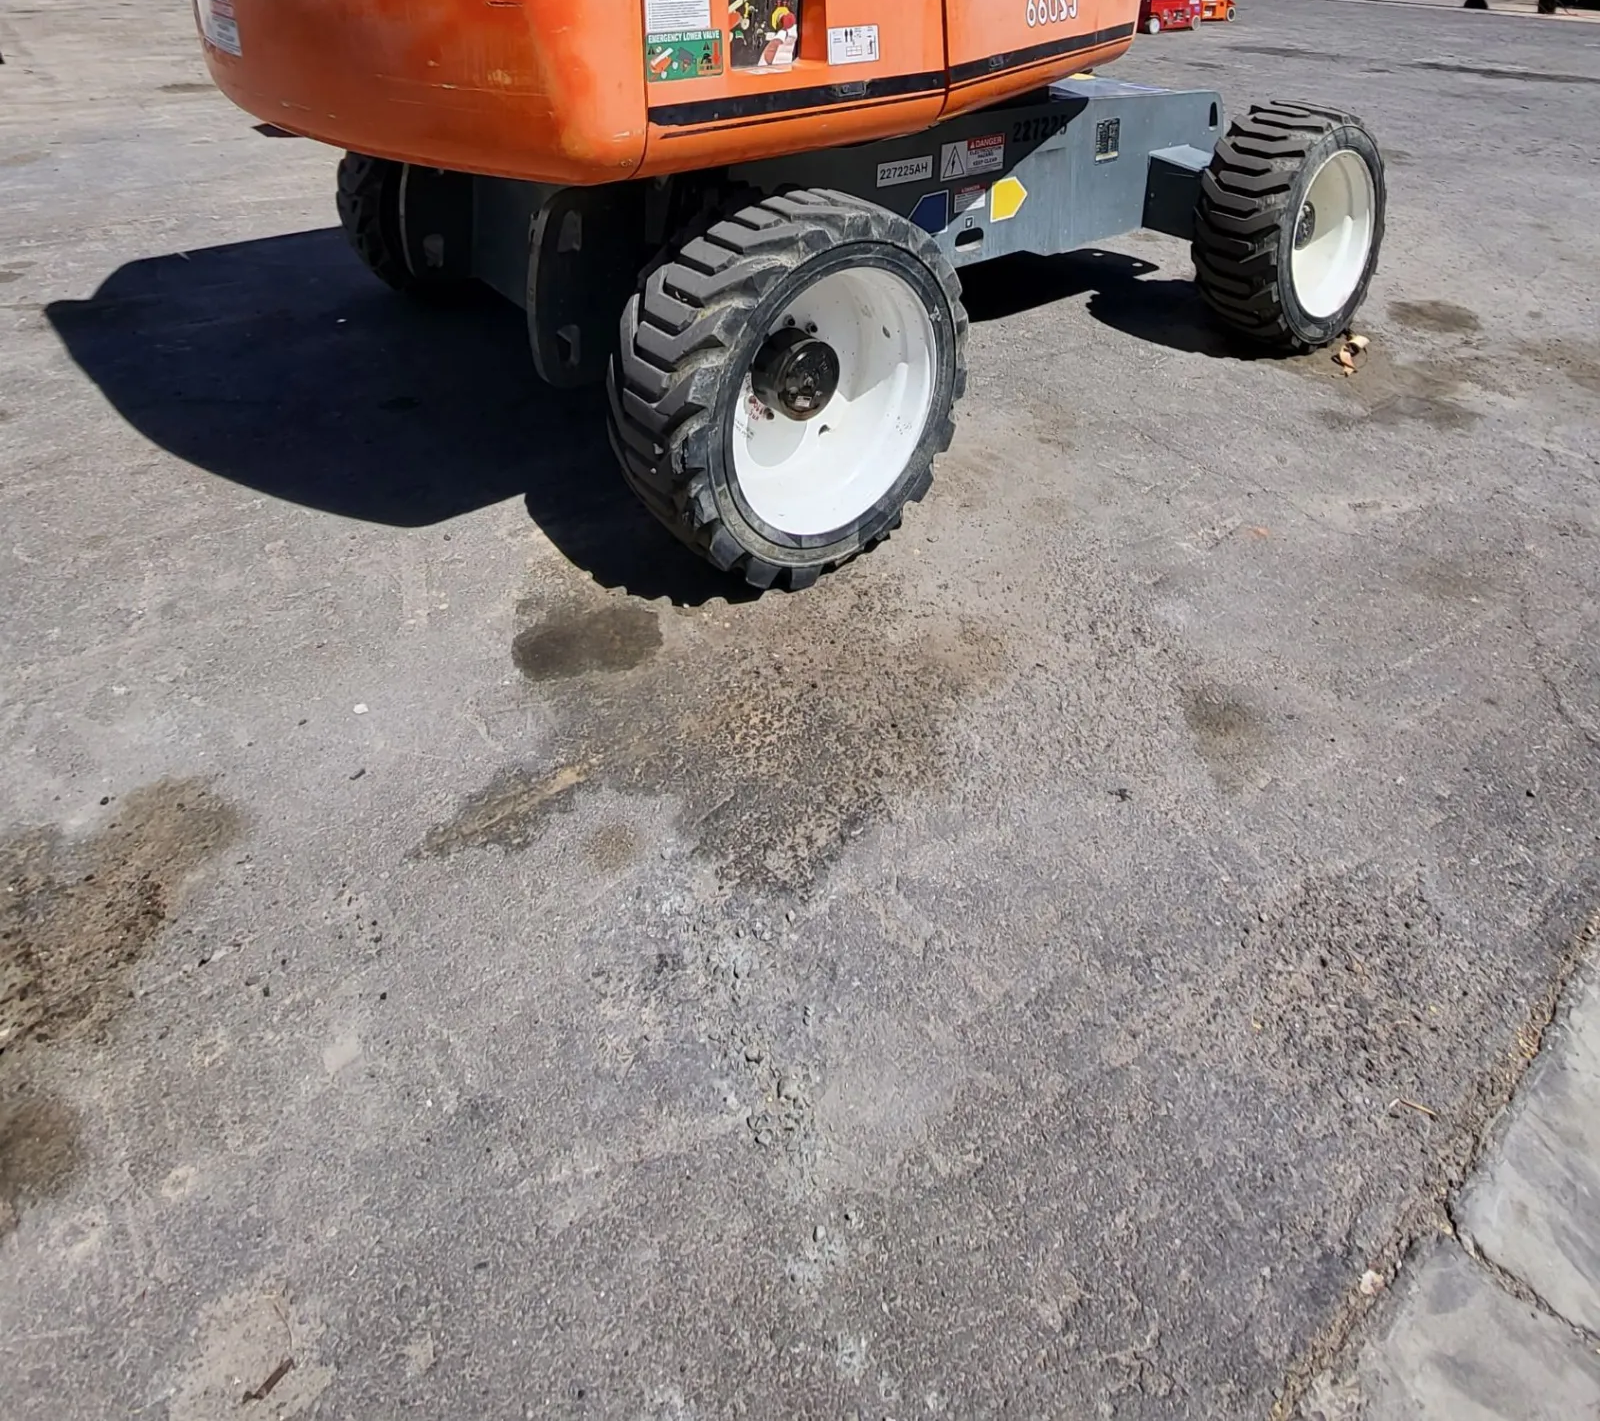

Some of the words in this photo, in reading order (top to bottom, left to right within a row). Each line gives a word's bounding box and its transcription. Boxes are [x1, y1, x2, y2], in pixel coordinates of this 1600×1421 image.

[648, 33, 682, 44] EMERGENCY
[683, 31, 702, 41] LOWER
[703, 29, 720, 39] VALVE
[1012, 114, 1068, 143] 227225
[975, 136, 1002, 148] DANGER
[879, 162, 928, 180] 227225AH
